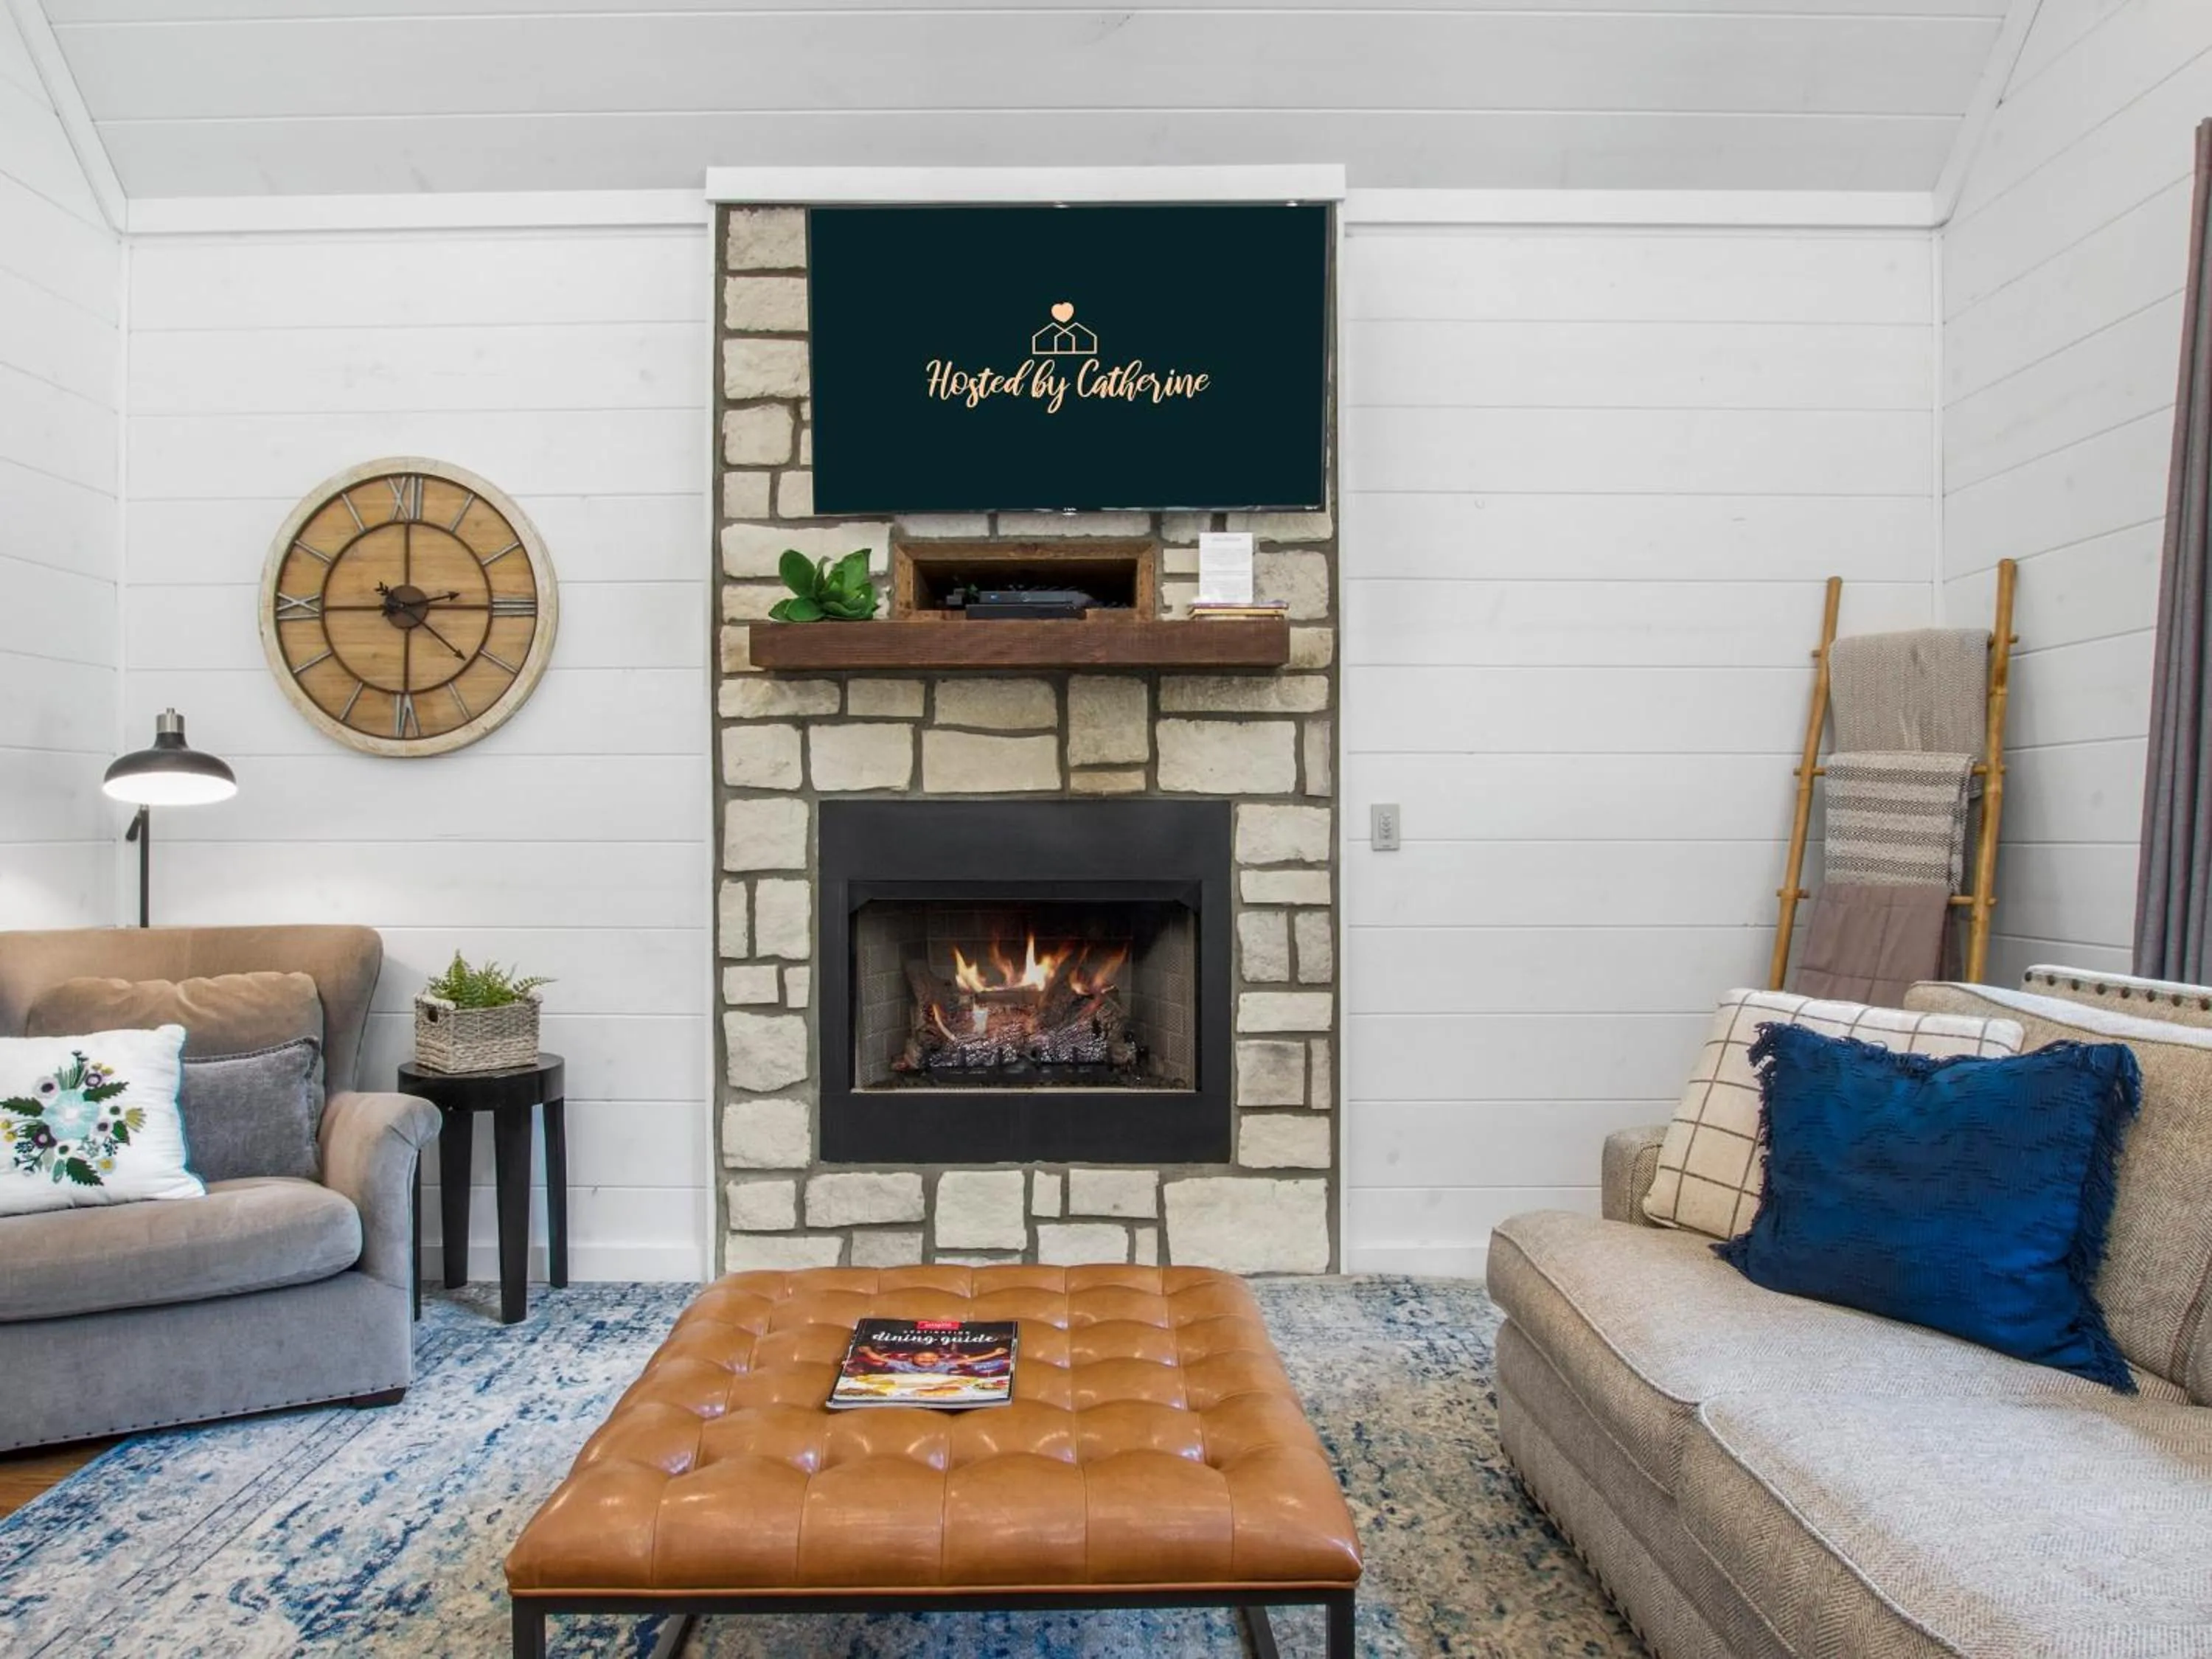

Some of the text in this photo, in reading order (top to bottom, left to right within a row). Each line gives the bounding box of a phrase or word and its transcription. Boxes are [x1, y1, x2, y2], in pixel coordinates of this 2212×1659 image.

[926, 358, 1210, 414] Hosted by Catherine
[872, 1331, 998, 1346] dining guide
